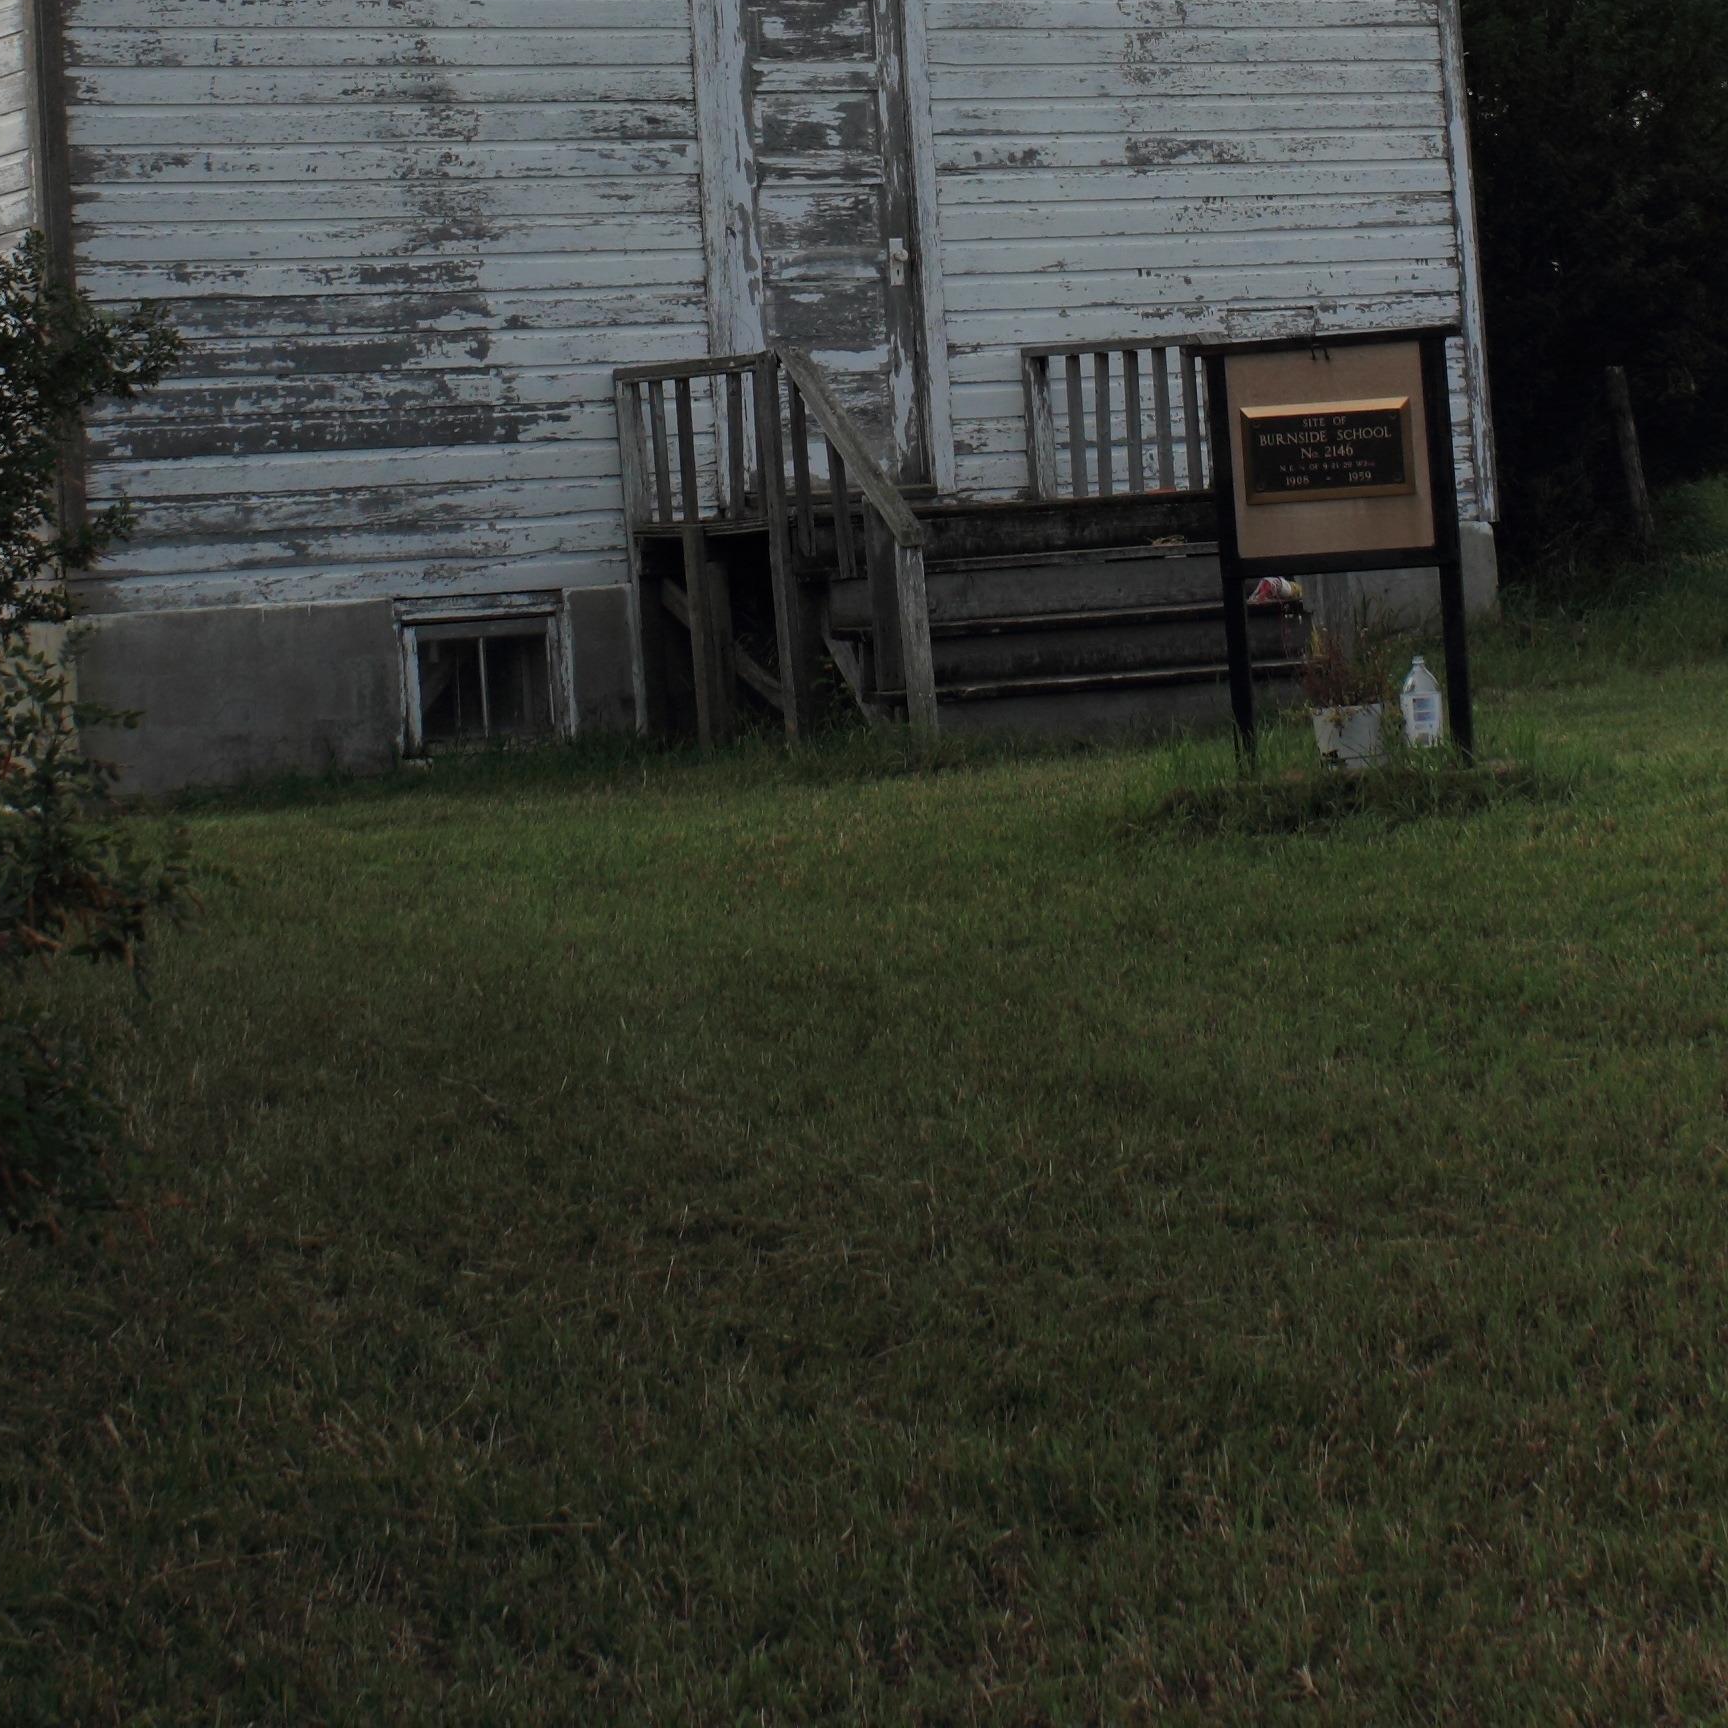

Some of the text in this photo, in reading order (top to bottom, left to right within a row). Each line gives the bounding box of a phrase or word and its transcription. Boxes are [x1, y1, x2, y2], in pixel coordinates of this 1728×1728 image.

[1302, 415, 1347, 428] SITE OF
[1259, 426, 1392, 447] BURNSIDE SCHOOL
[1324, 443, 1354, 458] 2146
[1285, 475, 1310, 486] 1908
[1348, 471, 1372, 482] 1959
